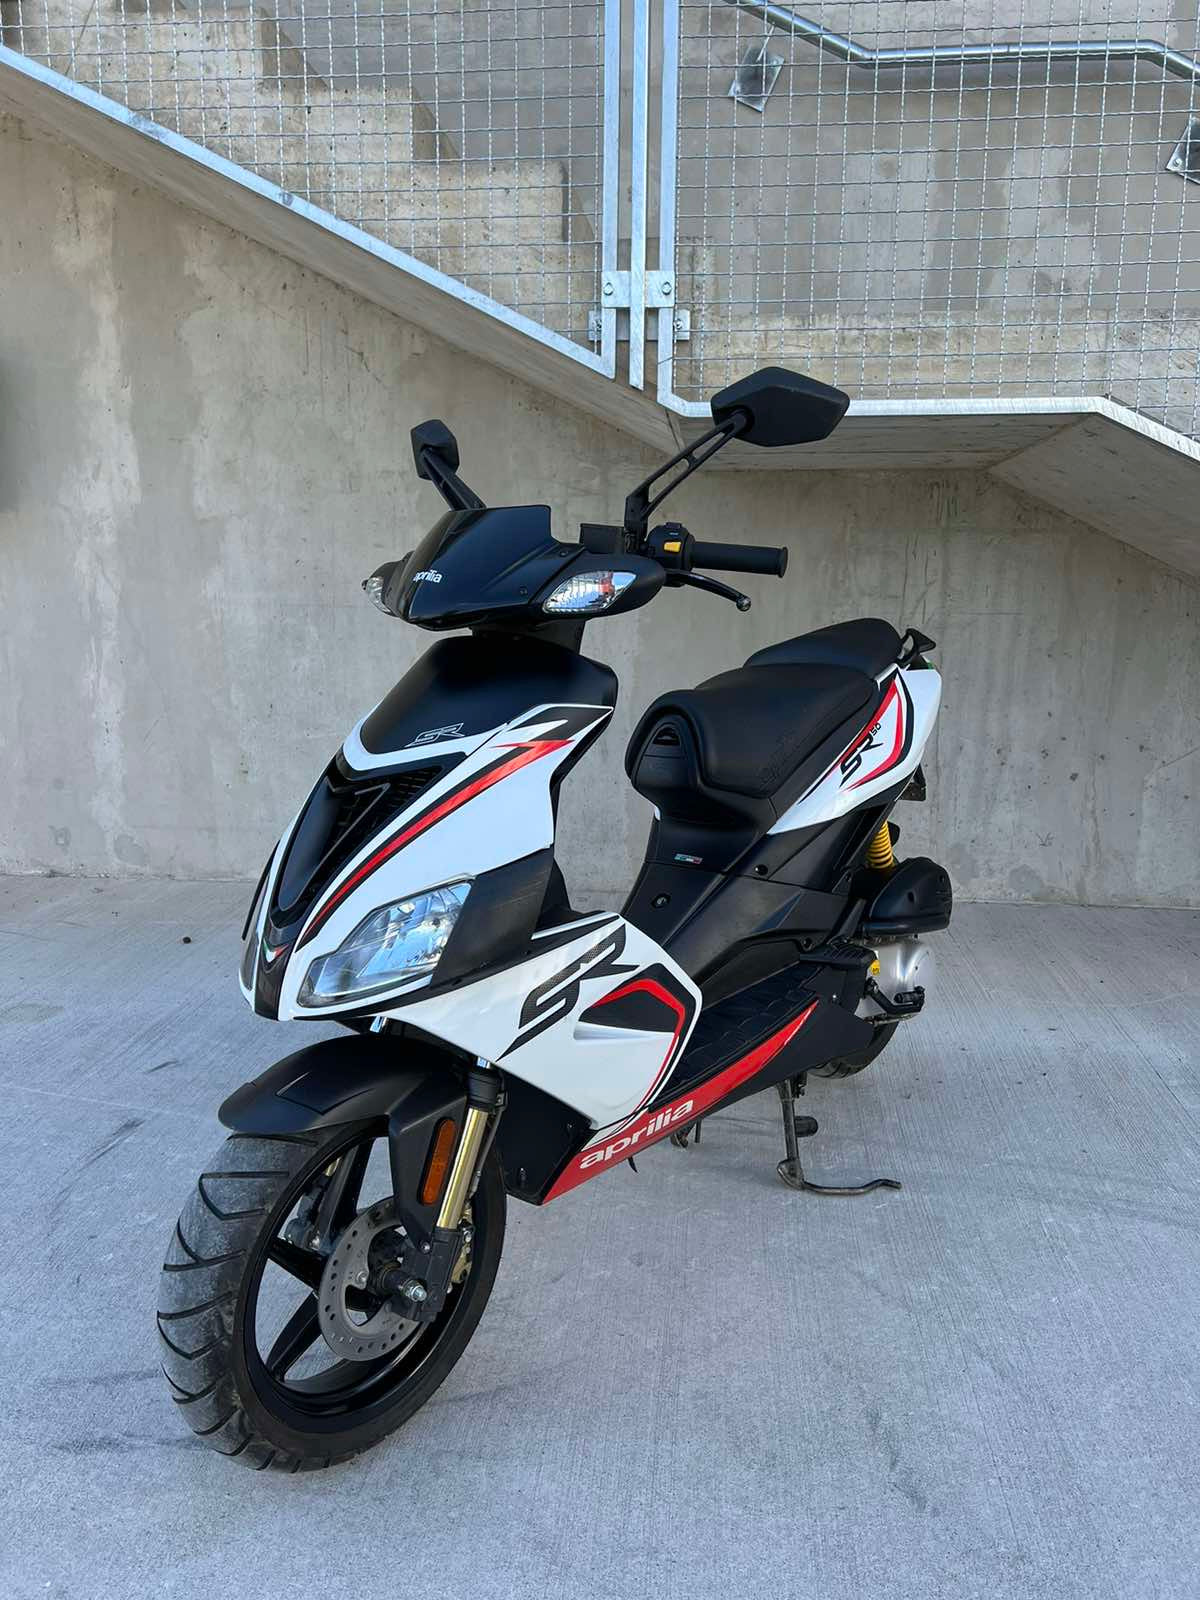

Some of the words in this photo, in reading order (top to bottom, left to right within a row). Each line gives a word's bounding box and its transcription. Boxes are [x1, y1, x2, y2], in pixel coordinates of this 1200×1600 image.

[404, 722, 465, 747] SR
[839, 733, 884, 788] SR
[871, 722, 882, 736] 50
[495, 923, 641, 1062] SR
[579, 1099, 694, 1169] aprilia
